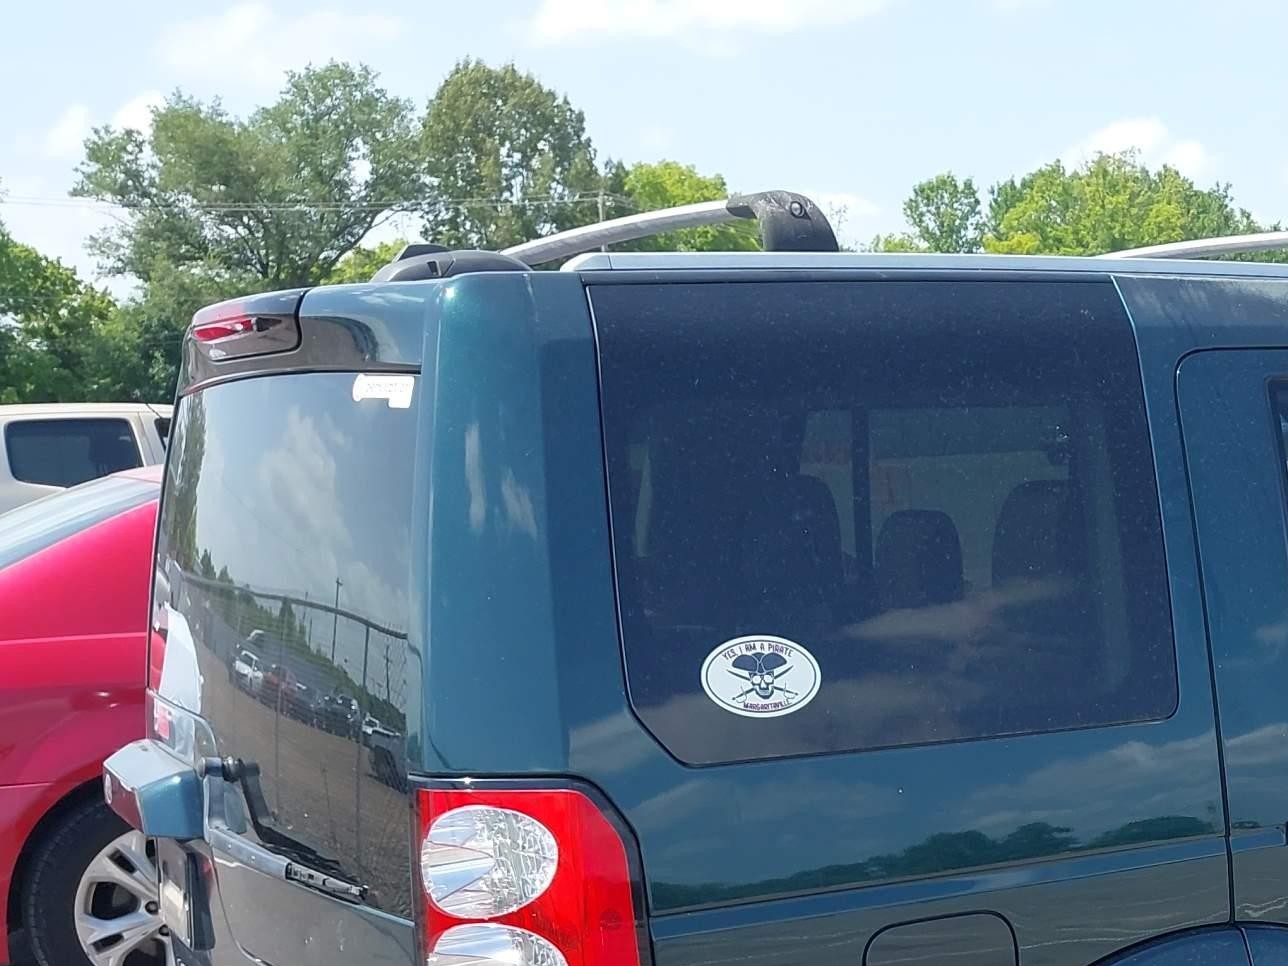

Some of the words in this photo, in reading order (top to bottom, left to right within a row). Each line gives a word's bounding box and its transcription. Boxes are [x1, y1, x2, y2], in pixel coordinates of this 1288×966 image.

[744, 642, 757, 652] AM
[759, 642, 765, 652] A
[767, 642, 794, 658] PIRATE
